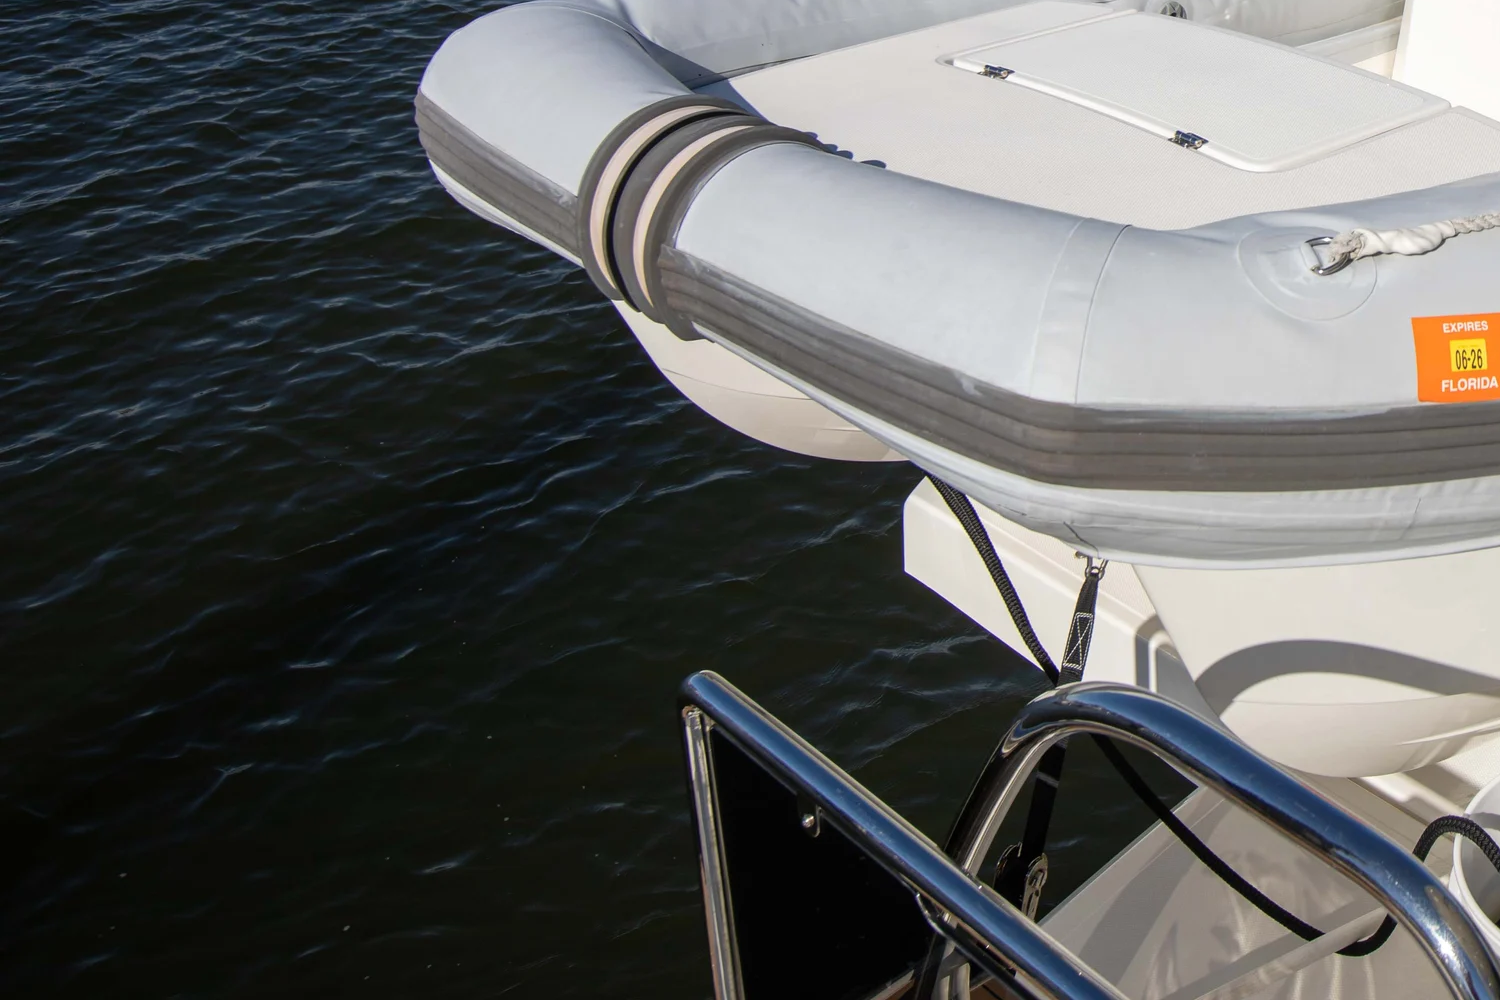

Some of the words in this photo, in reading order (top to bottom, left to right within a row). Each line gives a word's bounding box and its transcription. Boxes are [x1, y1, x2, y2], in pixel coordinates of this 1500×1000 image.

[1442, 320, 1489, 334] EXPIRES
[1455, 348, 1483, 370] 06-26
[1441, 376, 1499, 393] FLORIDA
